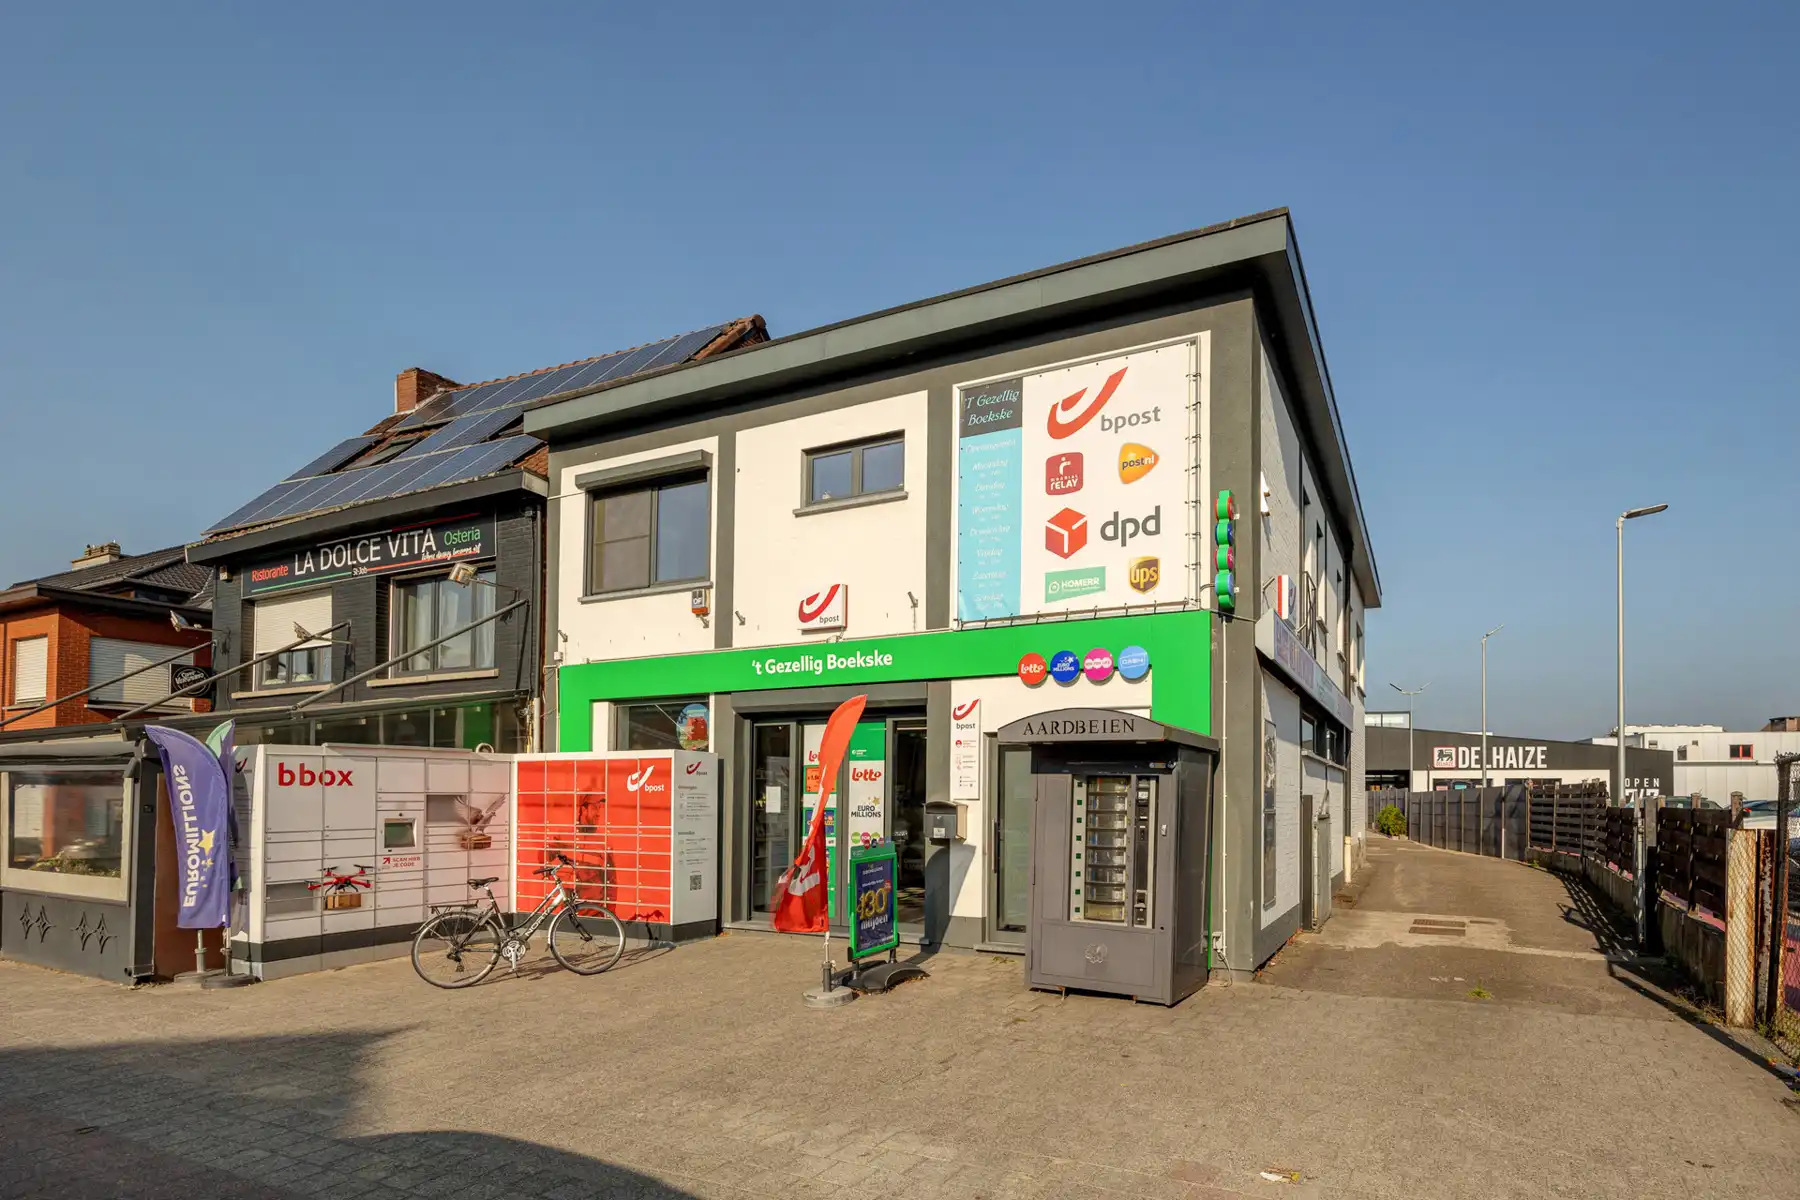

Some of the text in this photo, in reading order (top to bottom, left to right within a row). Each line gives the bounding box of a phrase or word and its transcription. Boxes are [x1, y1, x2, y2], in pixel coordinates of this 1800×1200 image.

[977, 389, 1020, 407] Gezellig
[968, 408, 1013, 426] Boekske
[1100, 406, 1161, 434] bpost
[1122, 455, 1155, 470] postnl
[1100, 505, 1161, 547] dpd
[251, 564, 289, 582] Ristorante
[294, 553, 315, 576] LA
[320, 537, 381, 571] DOLCE
[387, 527, 437, 559] VITA
[443, 527, 481, 546] Osteria
[1062, 577, 1100, 588] HOMERR
[1131, 567, 1158, 589] ups
[819, 614, 840, 625] bpost
[751, 649, 893, 675] 't Gezellig Boekske
[1020, 663, 1044, 674] Lotto
[956, 722, 976, 731] bpost
[1023, 719, 1135, 735] AARDBEIEN
[278, 762, 354, 787] bbox
[852, 768, 882, 781] Lotto
[1624, 777, 1660, 787] OPEN
[644, 783, 665, 794] bpost
[857, 888, 888, 920] 130
[525, 906, 554, 937] NORTA
